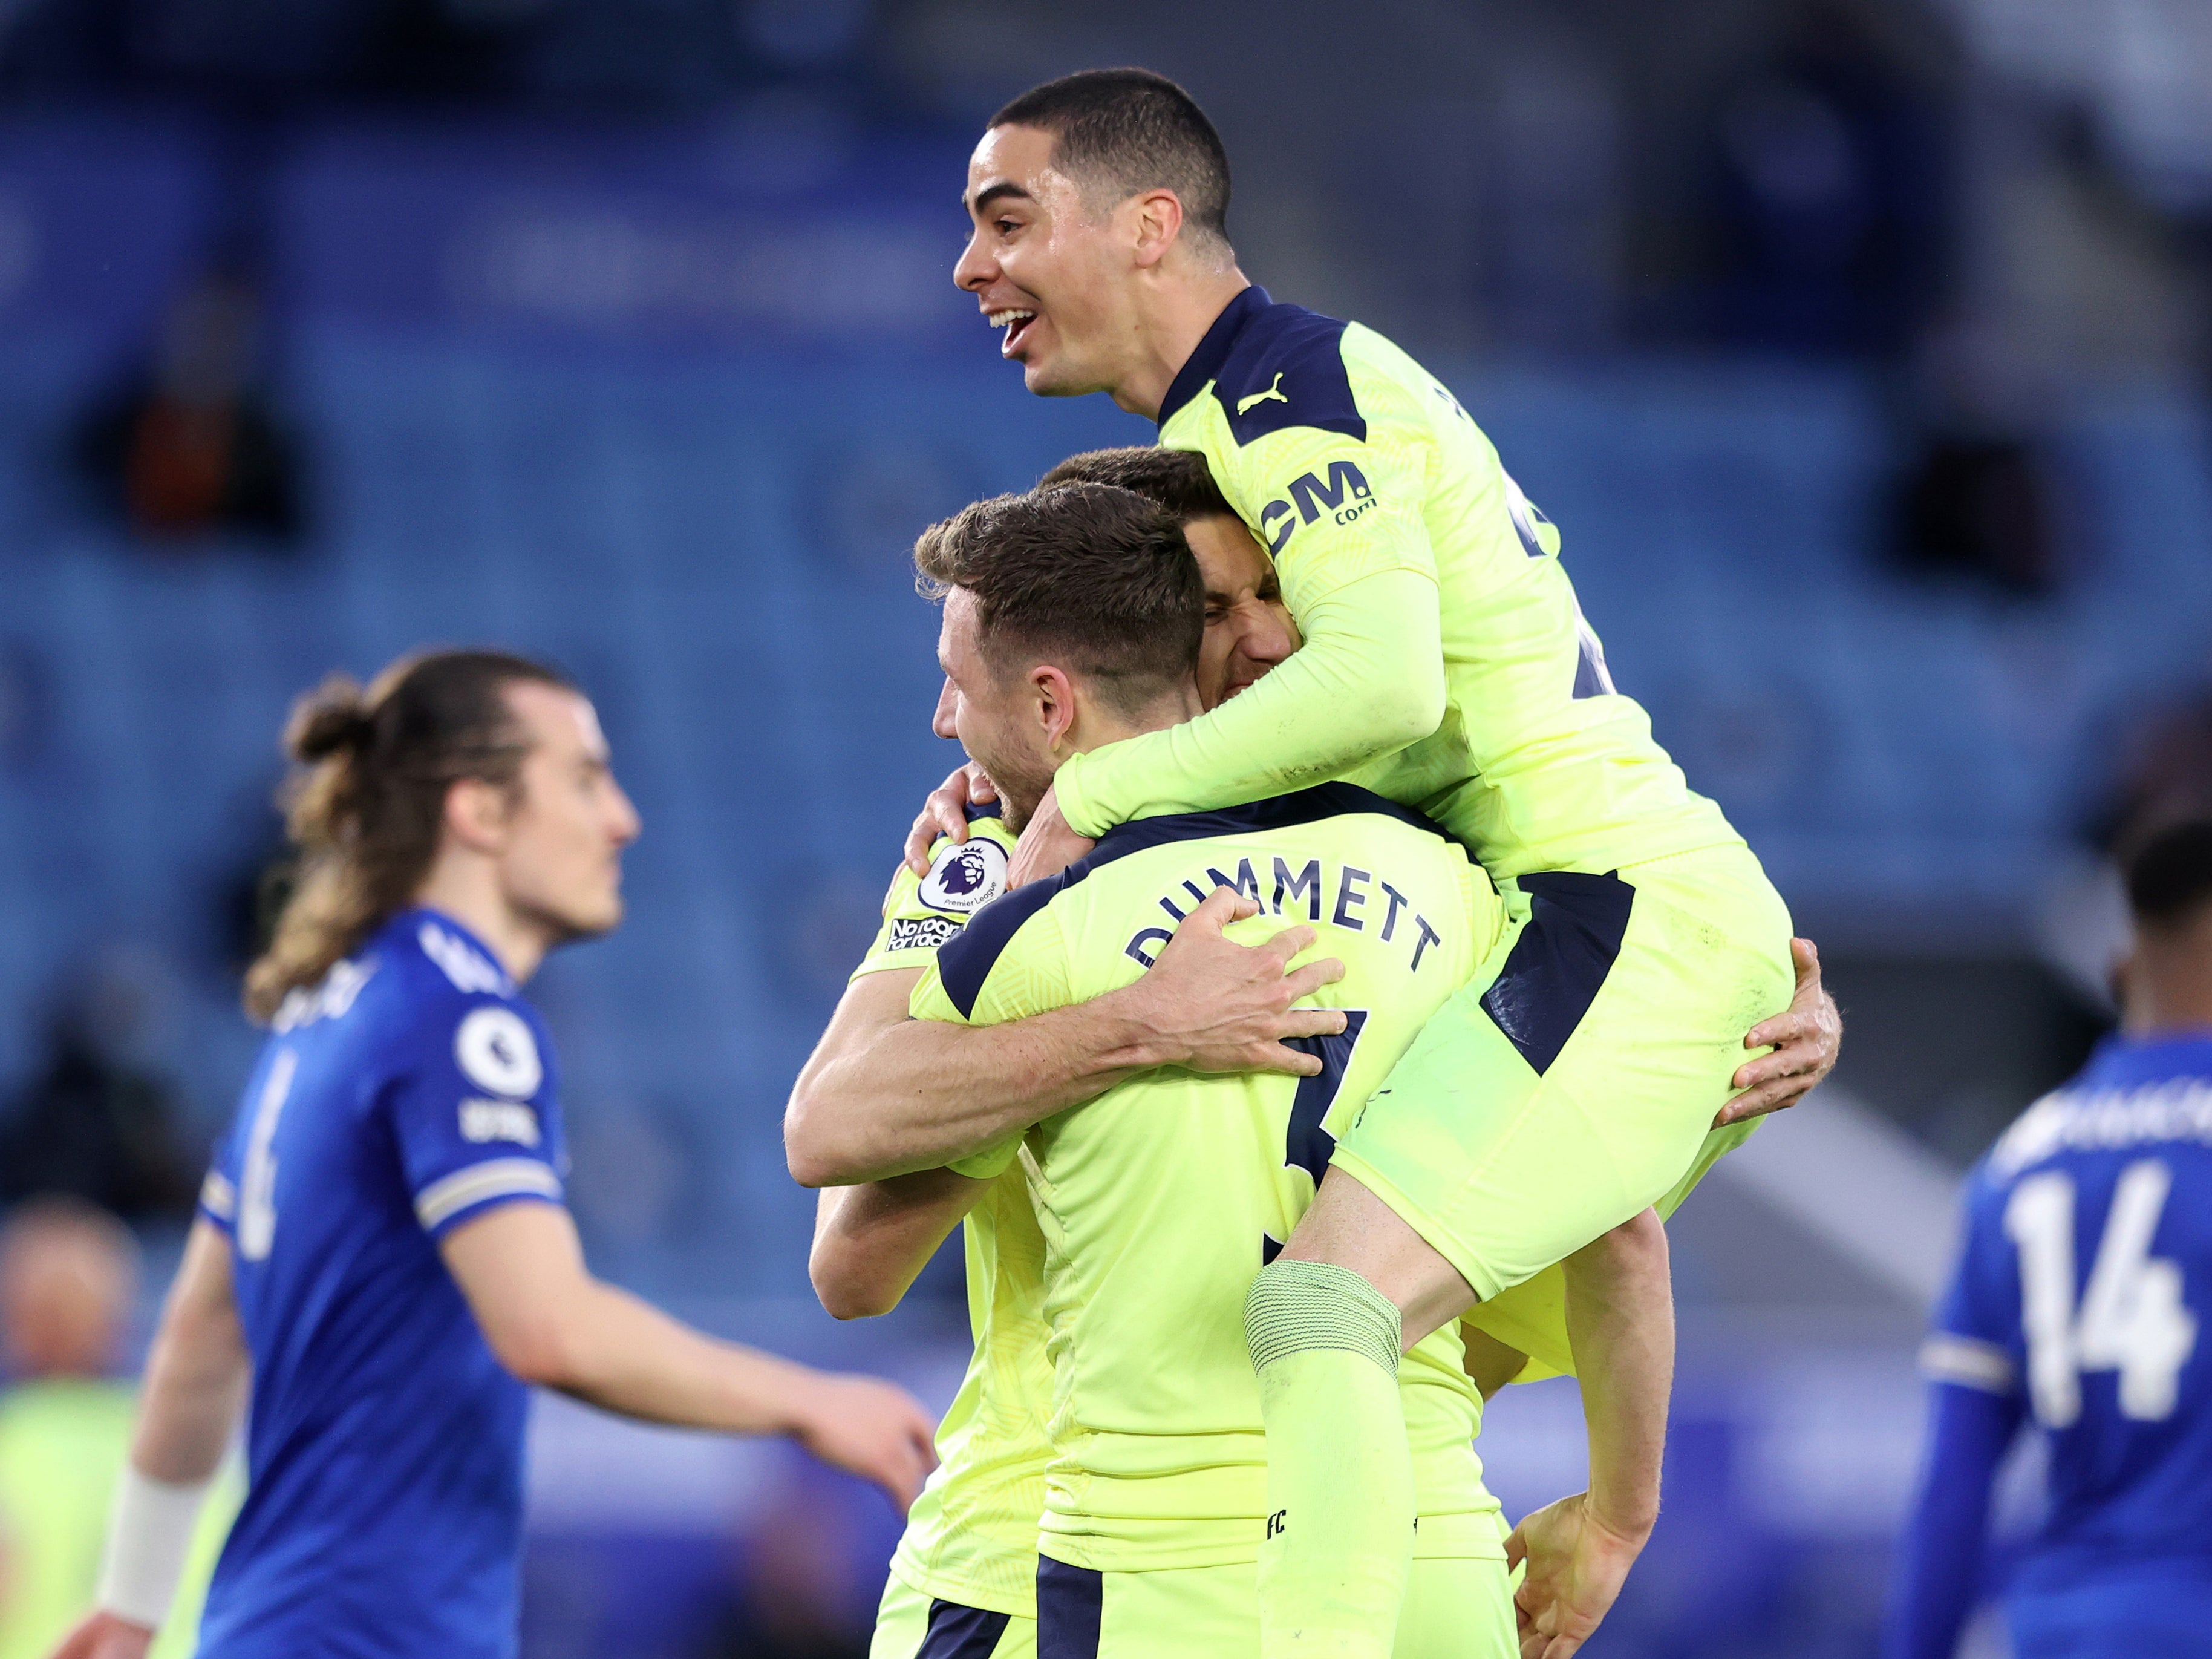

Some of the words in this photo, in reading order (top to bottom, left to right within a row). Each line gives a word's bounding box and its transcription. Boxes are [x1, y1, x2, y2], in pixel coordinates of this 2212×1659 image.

[1335, 498, 1377, 526] com
[974, 882, 997, 905] League
[890, 920, 918, 937] No
[2002, 1160, 2197, 1428] 14
